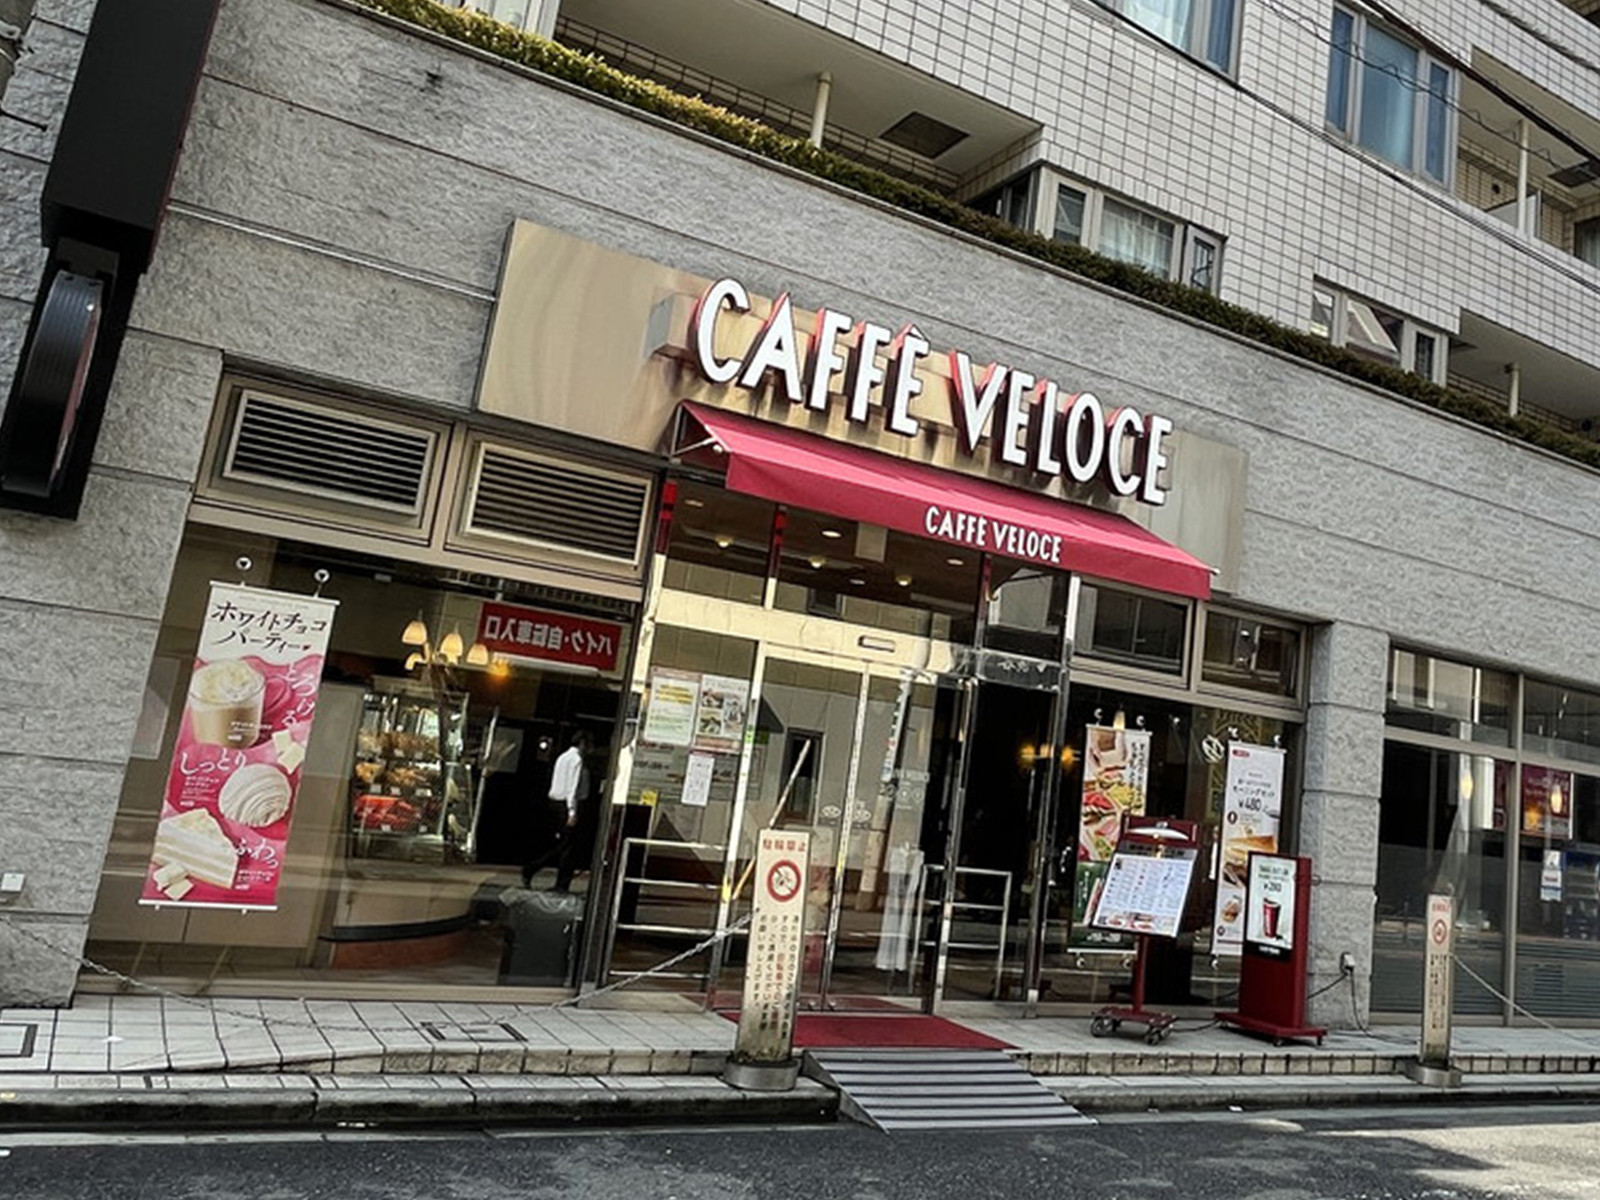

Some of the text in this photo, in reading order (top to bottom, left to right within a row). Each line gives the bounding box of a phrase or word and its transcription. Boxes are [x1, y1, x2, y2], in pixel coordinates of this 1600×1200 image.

[695, 278, 1174, 505] CAFFÈ VELOCE
[991, 520, 1063, 564] VELOCE
[211, 600, 327, 635] ホワイトチョコ
[211, 627, 302, 653] パーティー
[180, 747, 247, 776] しっとり
